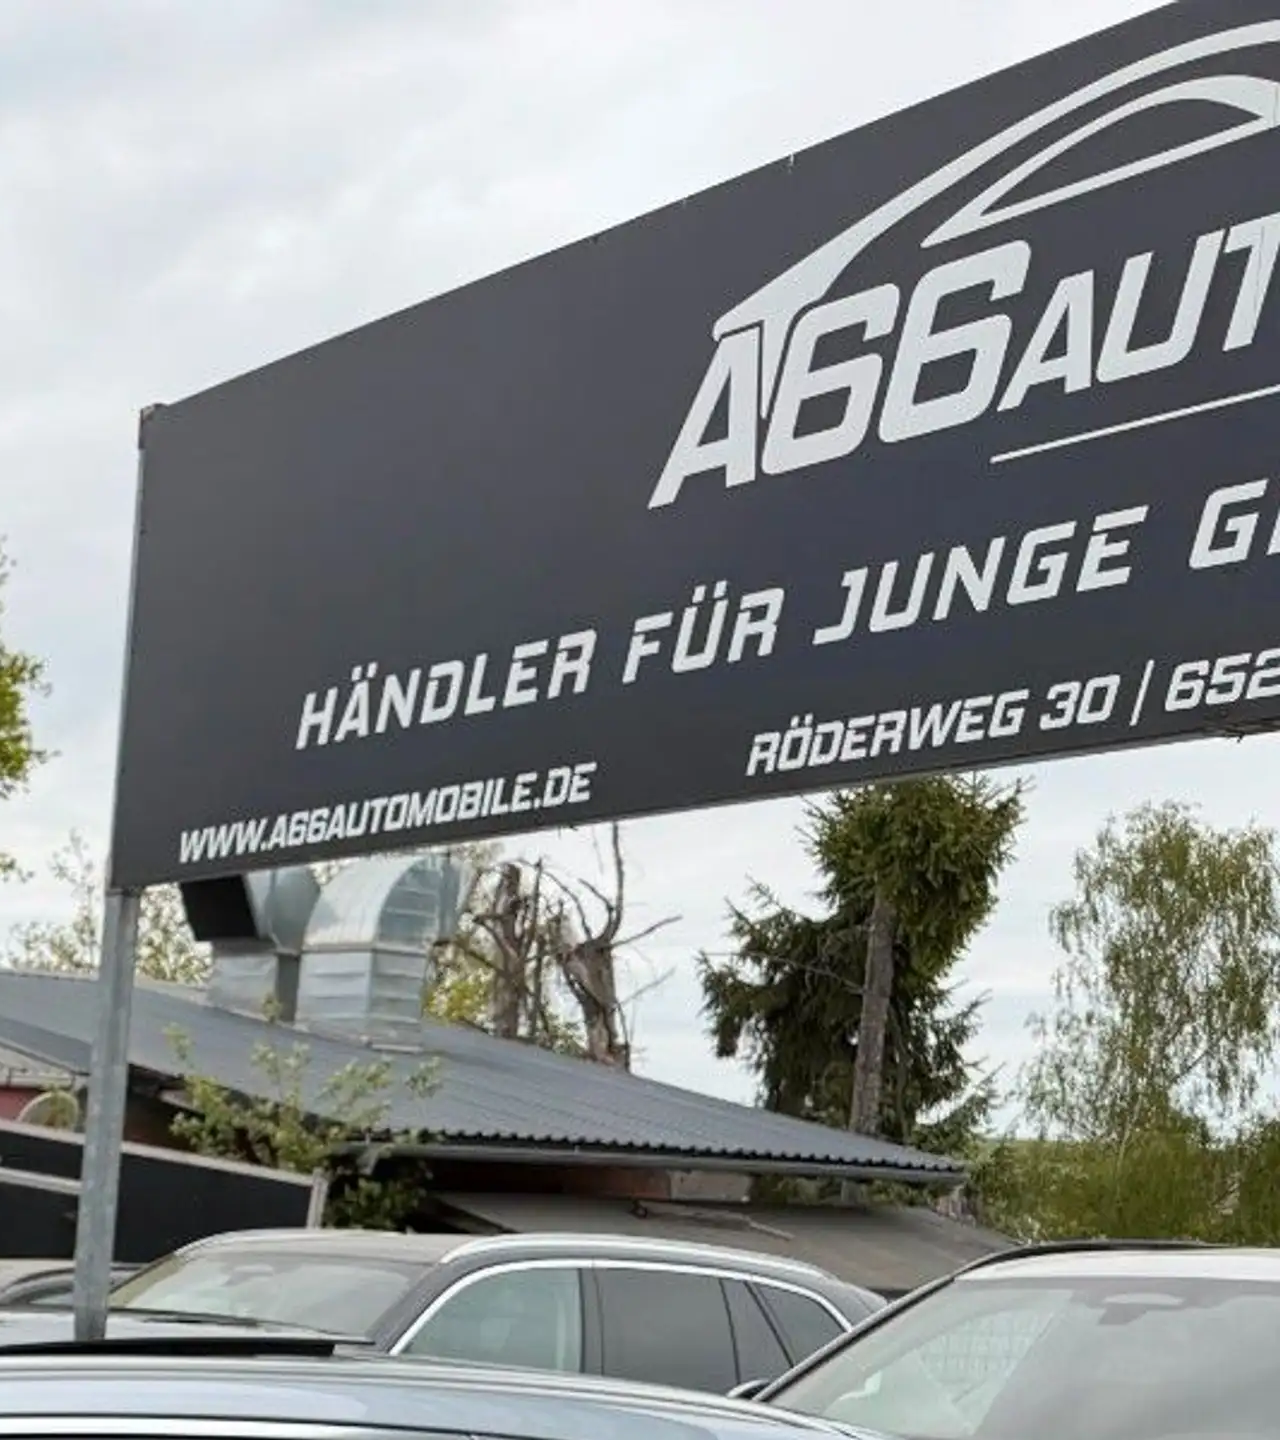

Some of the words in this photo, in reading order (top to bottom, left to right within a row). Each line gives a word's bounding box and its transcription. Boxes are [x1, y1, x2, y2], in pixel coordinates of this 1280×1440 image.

[295, 628, 597, 750] HÄNDLER
[621, 580, 785, 684] FÜR
[812, 505, 1149, 645] JUNGE
[1188, 478, 1280, 568] G
[746, 689, 1028, 775] RÖDERWEG
[1040, 674, 1120, 729] 30
[1165, 647, 1280, 711] 652
[179, 762, 596, 863] WWW.A66AUTOMOBILE.DE
